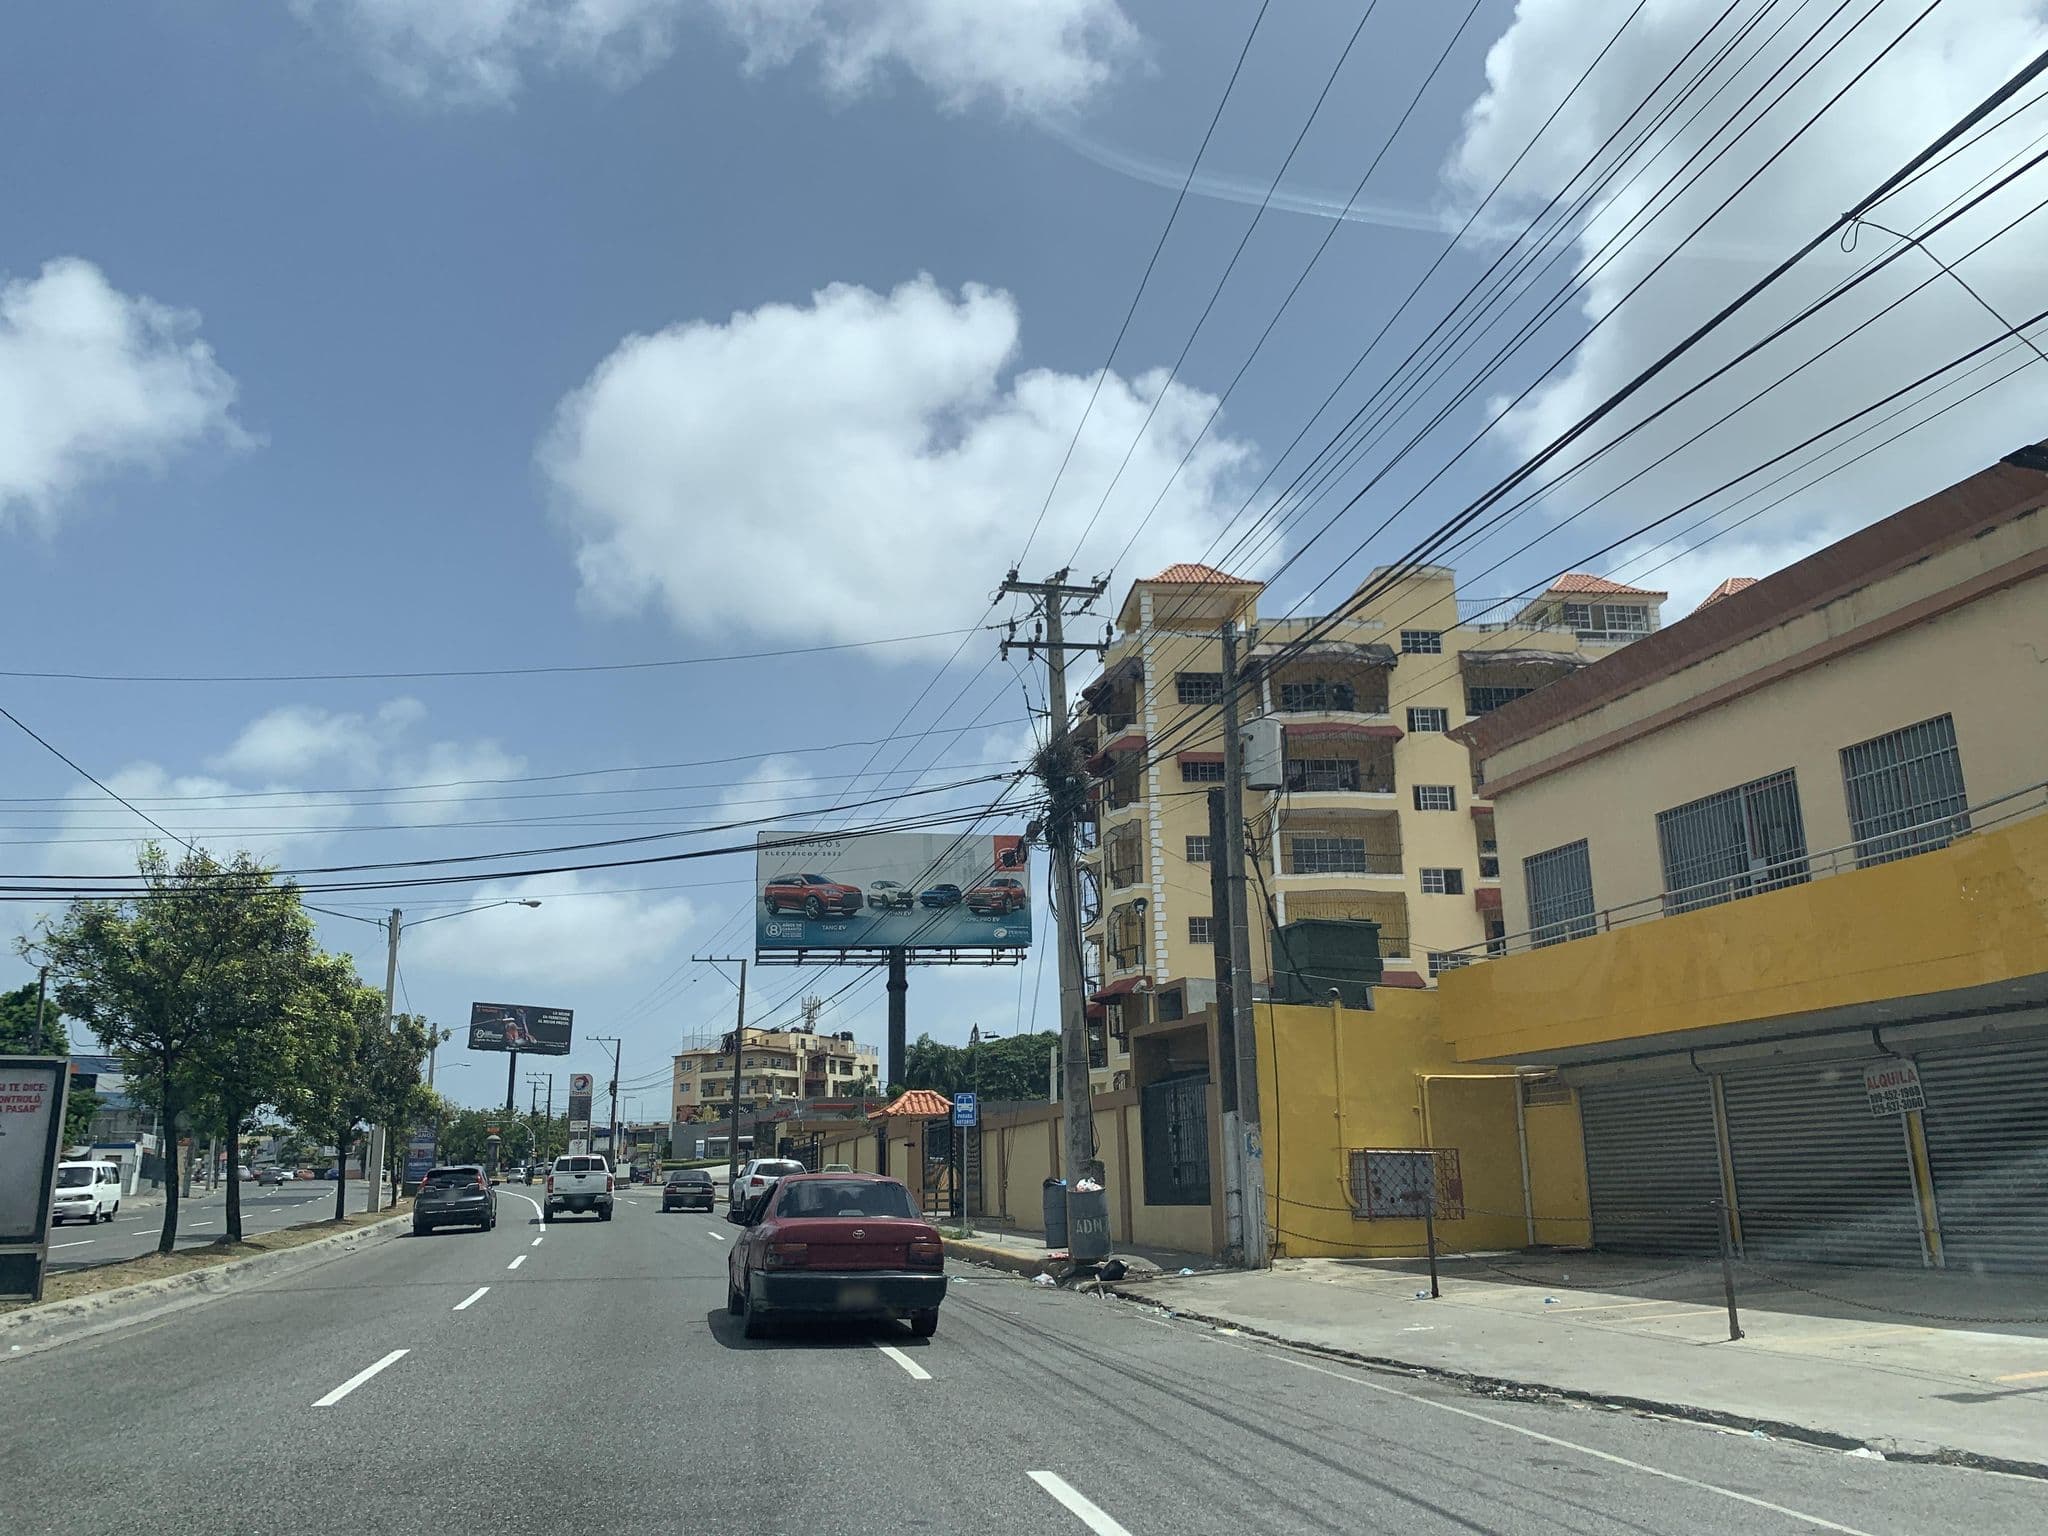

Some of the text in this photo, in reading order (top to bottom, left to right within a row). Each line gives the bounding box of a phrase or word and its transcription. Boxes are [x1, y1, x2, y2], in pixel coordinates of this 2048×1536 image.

[769, 924, 779, 936] 8
[1866, 1068, 1918, 1090] ALQUILA
[9, 1083, 20, 1091] TE
